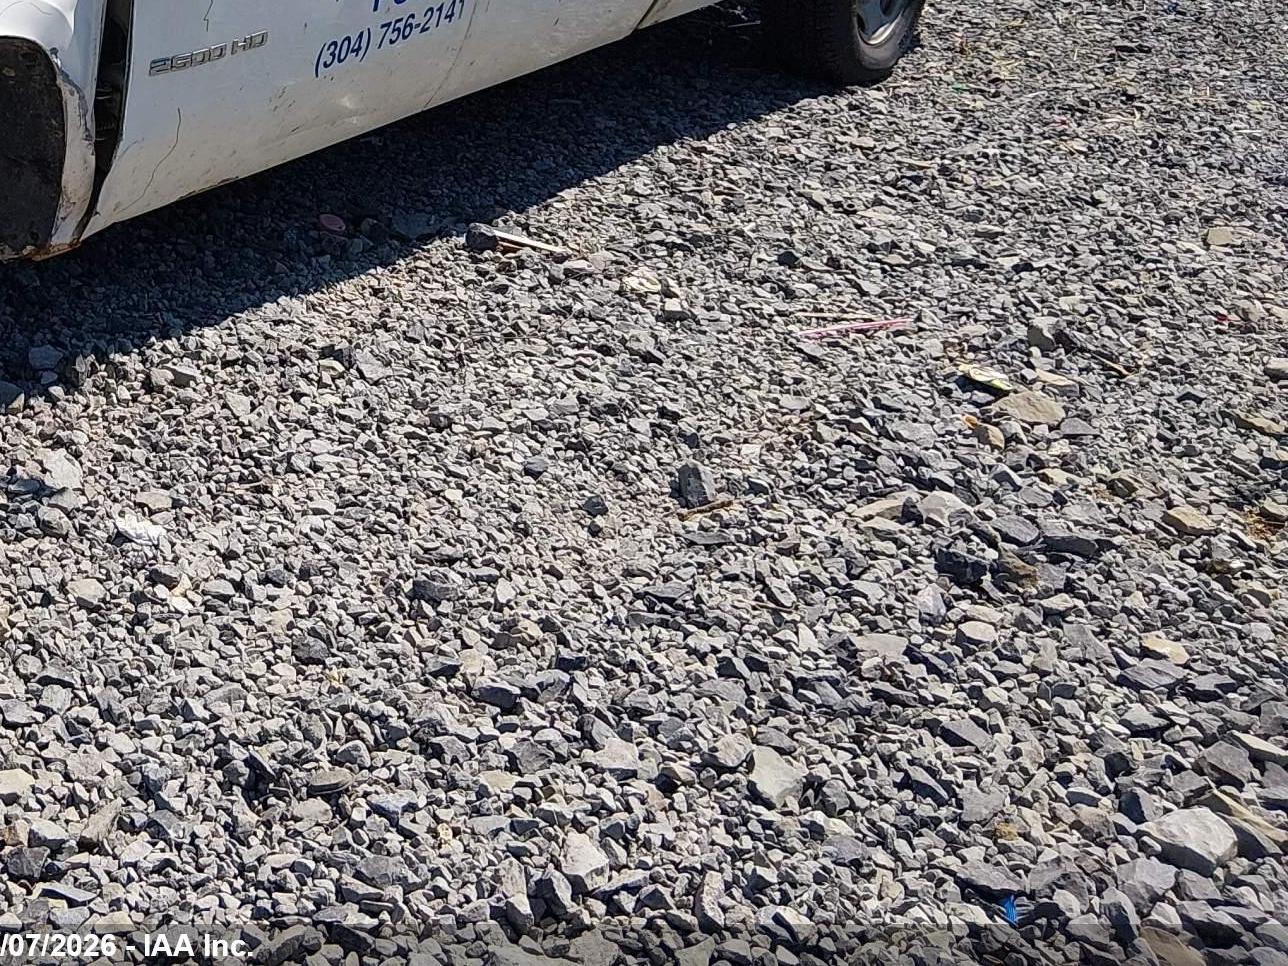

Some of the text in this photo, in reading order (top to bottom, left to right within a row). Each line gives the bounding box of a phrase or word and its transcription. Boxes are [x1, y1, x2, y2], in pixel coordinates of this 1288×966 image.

[149, 29, 269, 76] 2500 HD
[314, 27, 372, 78] (304)
